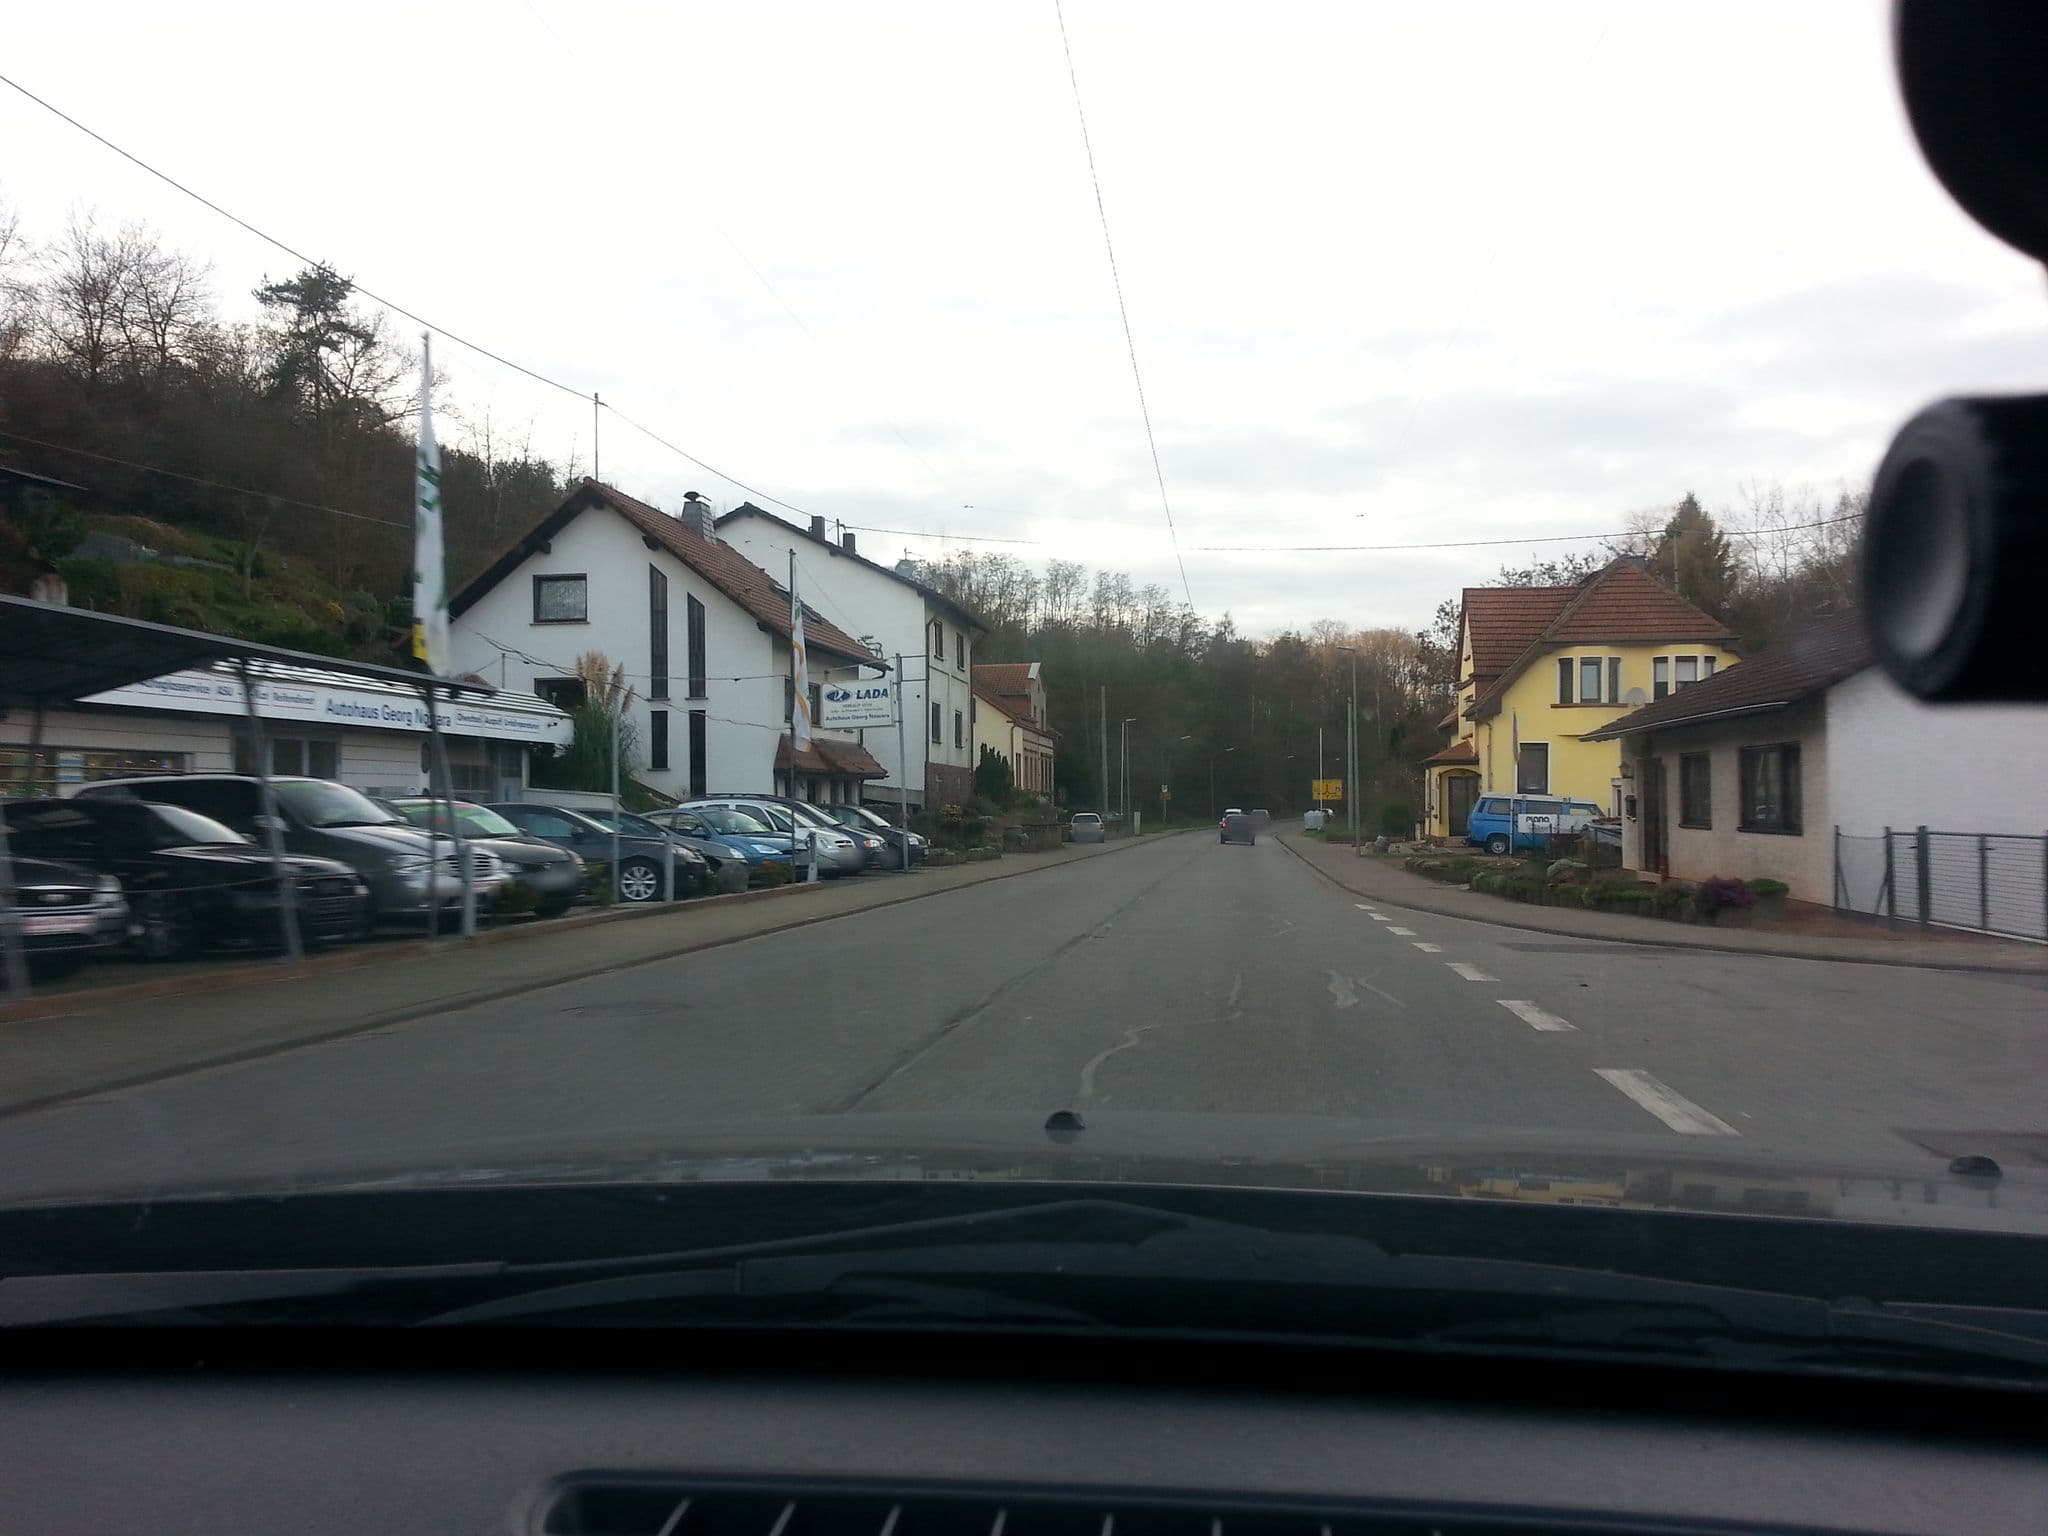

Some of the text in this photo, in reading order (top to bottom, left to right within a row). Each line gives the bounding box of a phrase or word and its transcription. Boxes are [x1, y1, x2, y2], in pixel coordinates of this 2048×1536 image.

[856, 688, 889, 700] LADA
[326, 698, 380, 719] Autohaus
[382, 704, 412, 727] Georg
[414, 708, 452, 728] Noara
